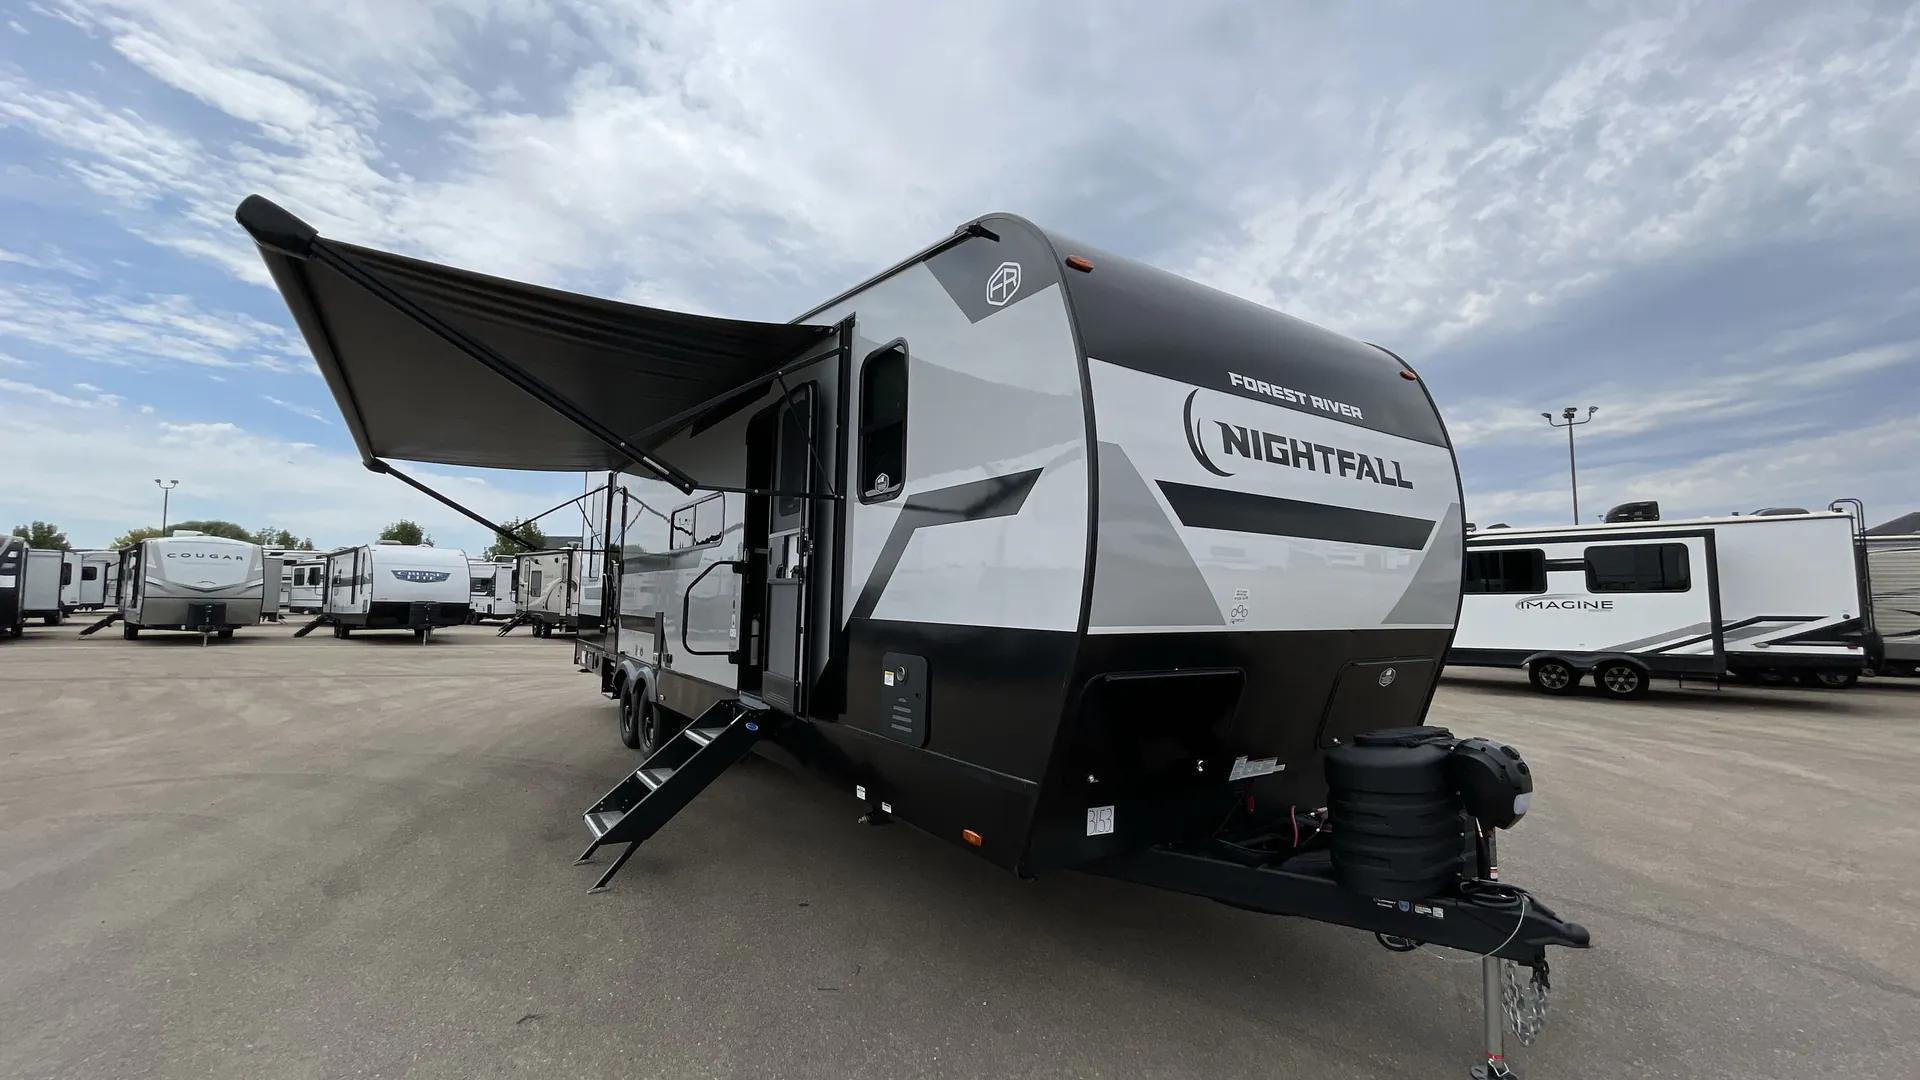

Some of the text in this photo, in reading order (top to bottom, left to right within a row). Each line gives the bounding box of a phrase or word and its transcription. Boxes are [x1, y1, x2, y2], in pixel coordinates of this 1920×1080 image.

[1228, 371, 1363, 420] FOREST RIVER
[1213, 420, 1413, 489] NIGHTFALL
[166, 552, 244, 561] COUGAR
[1520, 600, 1614, 610] IMAGINE
[1088, 808, 1112, 834] 3153
